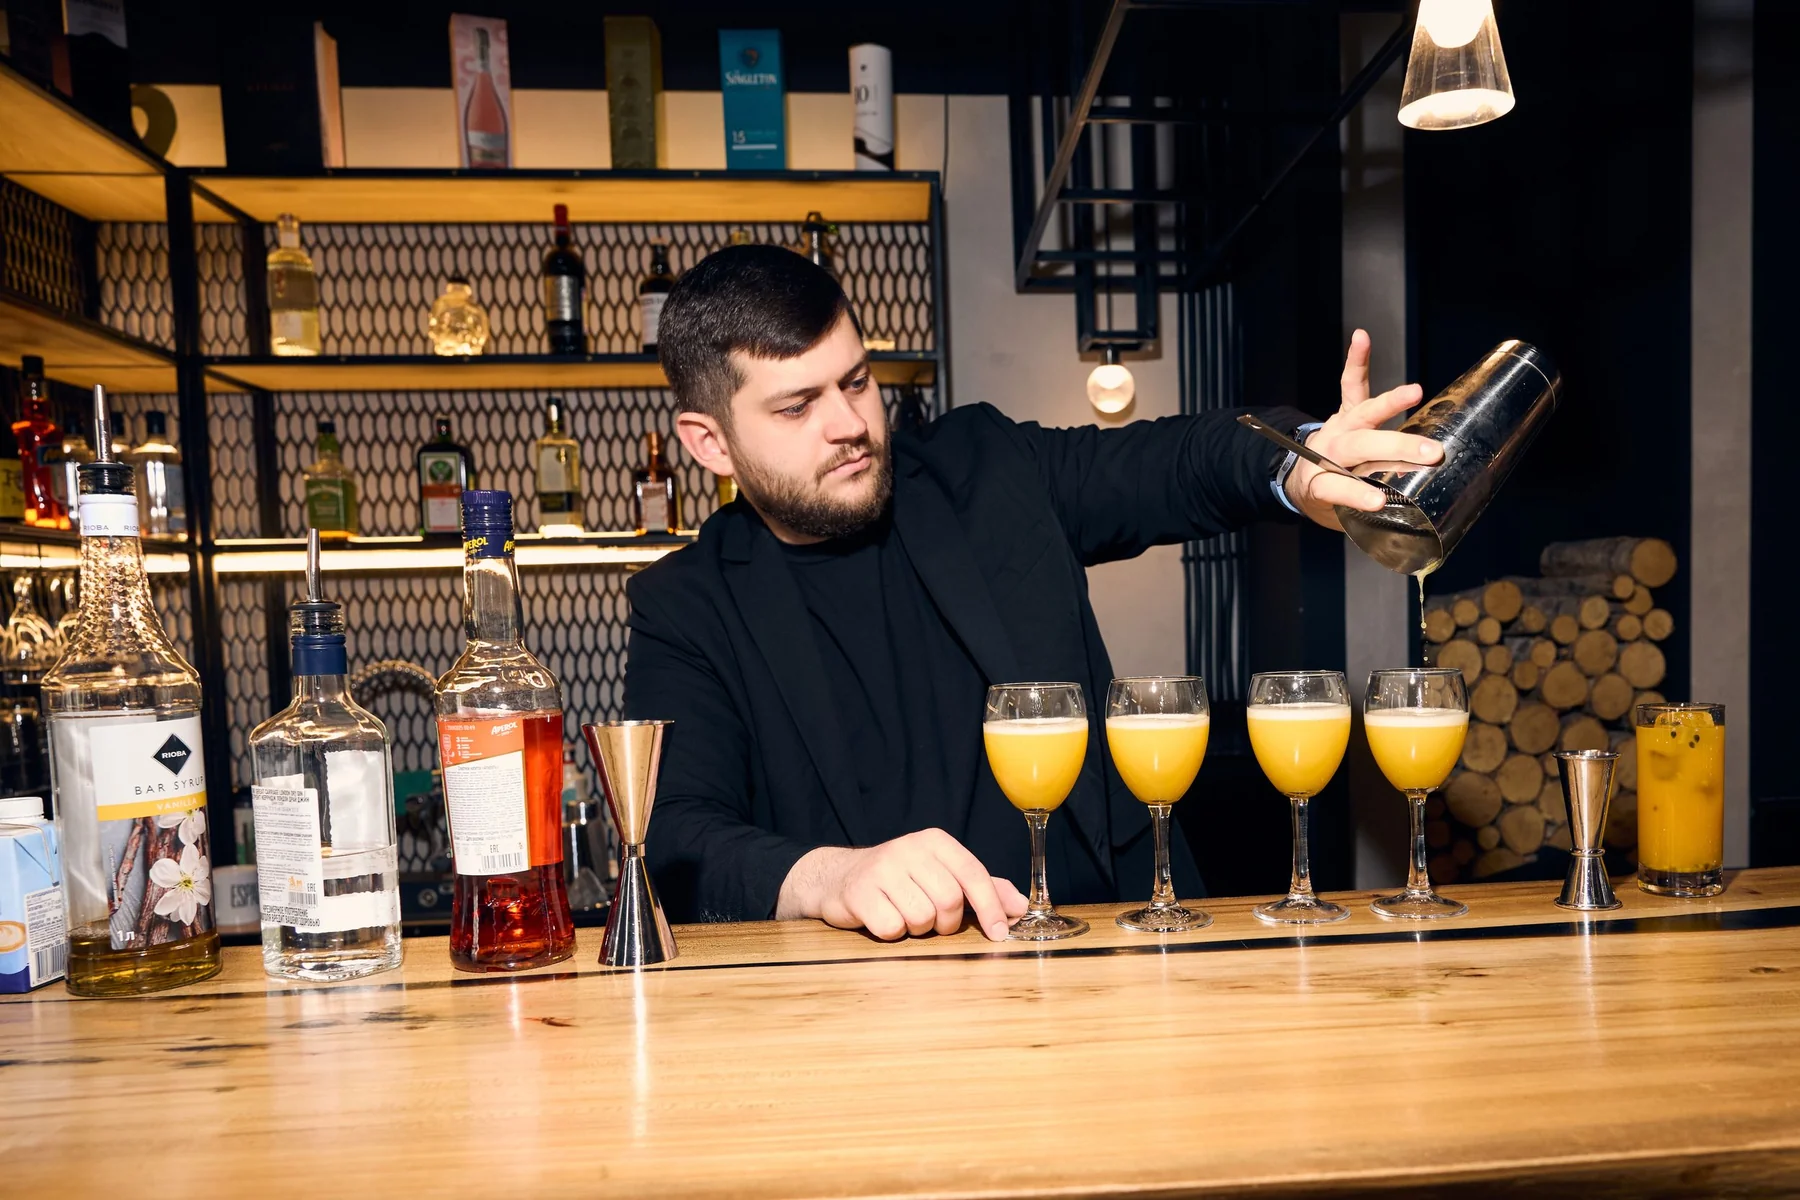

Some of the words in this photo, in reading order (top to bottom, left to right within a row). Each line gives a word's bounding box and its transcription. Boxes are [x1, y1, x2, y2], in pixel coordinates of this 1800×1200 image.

[83, 524, 110, 532] RIOBA
[463, 536, 489, 551] PEROL
[491, 721, 518, 735] APEROL
[161, 750, 187, 759] RIOBA
[134, 783, 165, 796] BAR
[156, 797, 197, 811] VANILLA
